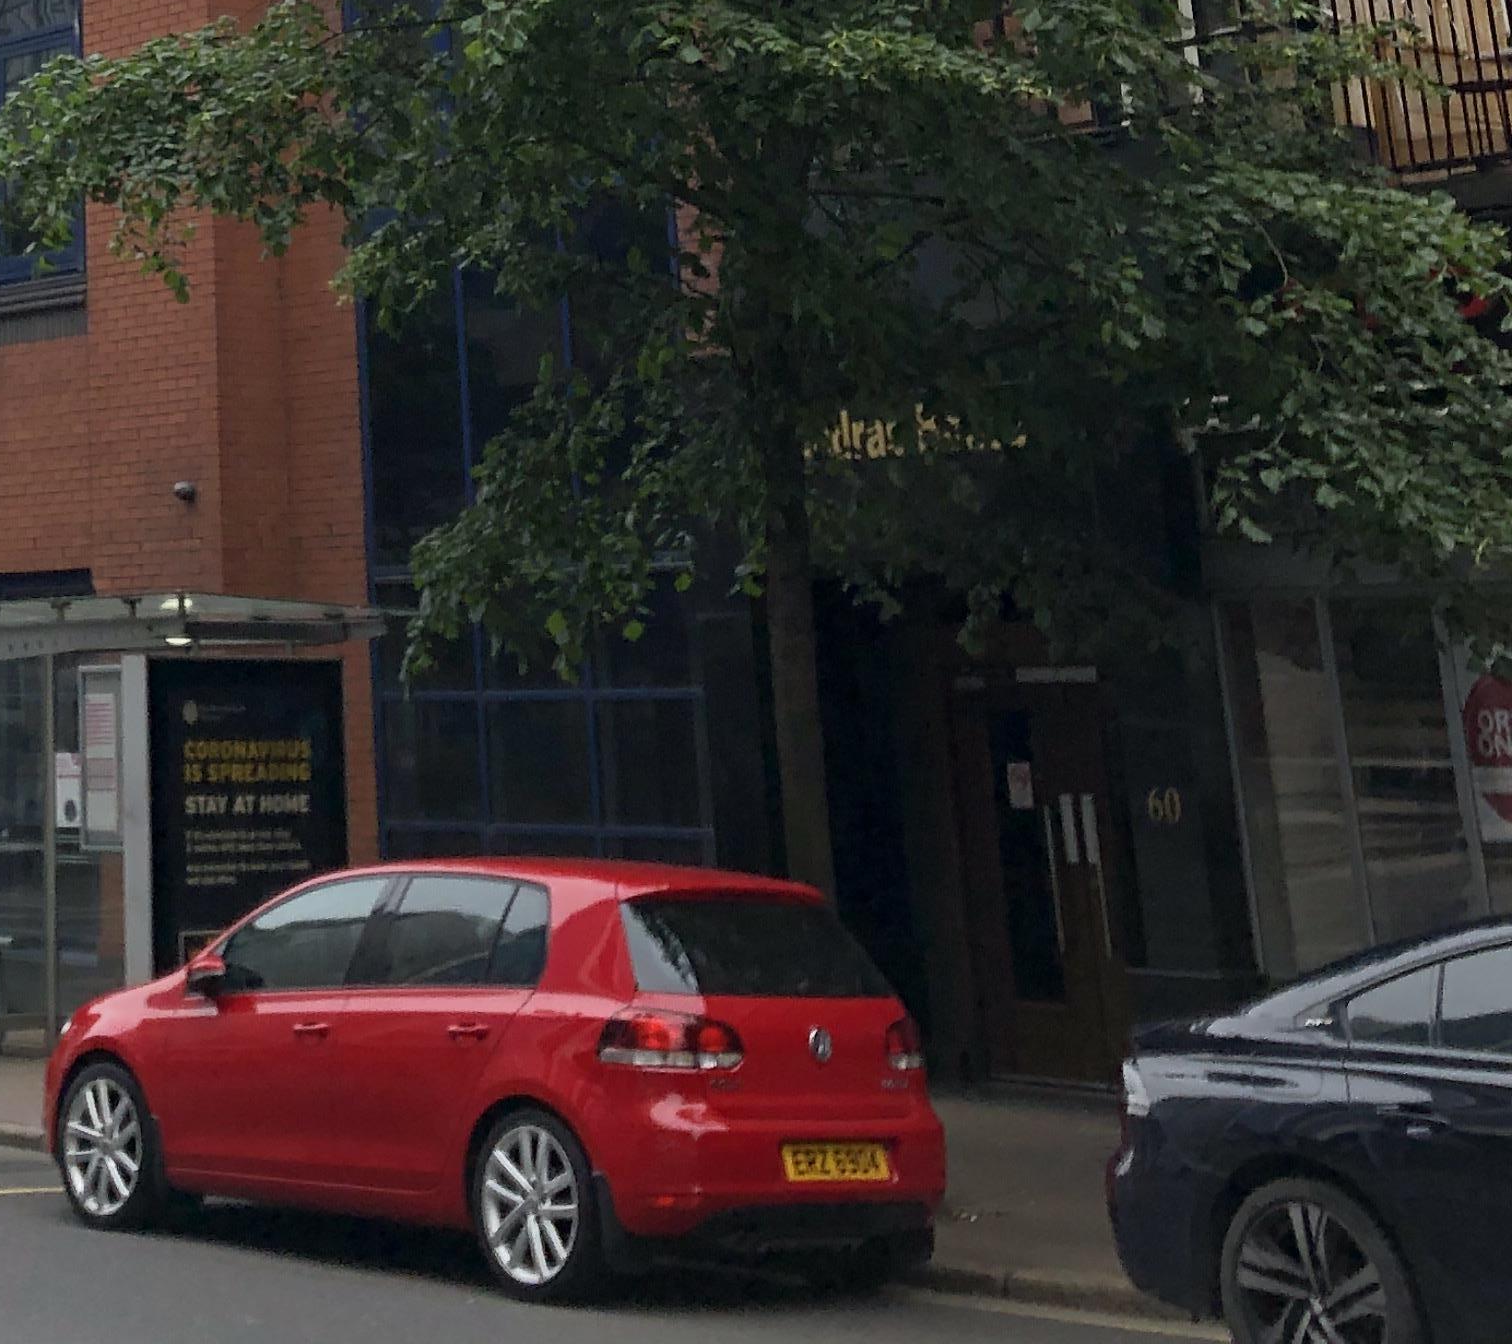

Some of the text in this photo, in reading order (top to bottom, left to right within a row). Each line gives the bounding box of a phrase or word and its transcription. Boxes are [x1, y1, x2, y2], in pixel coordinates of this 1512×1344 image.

[184, 739, 312, 759] CORONAVIRUS
[185, 794, 311, 814] STAY AT HOME
[1148, 786, 1181, 824] 60
